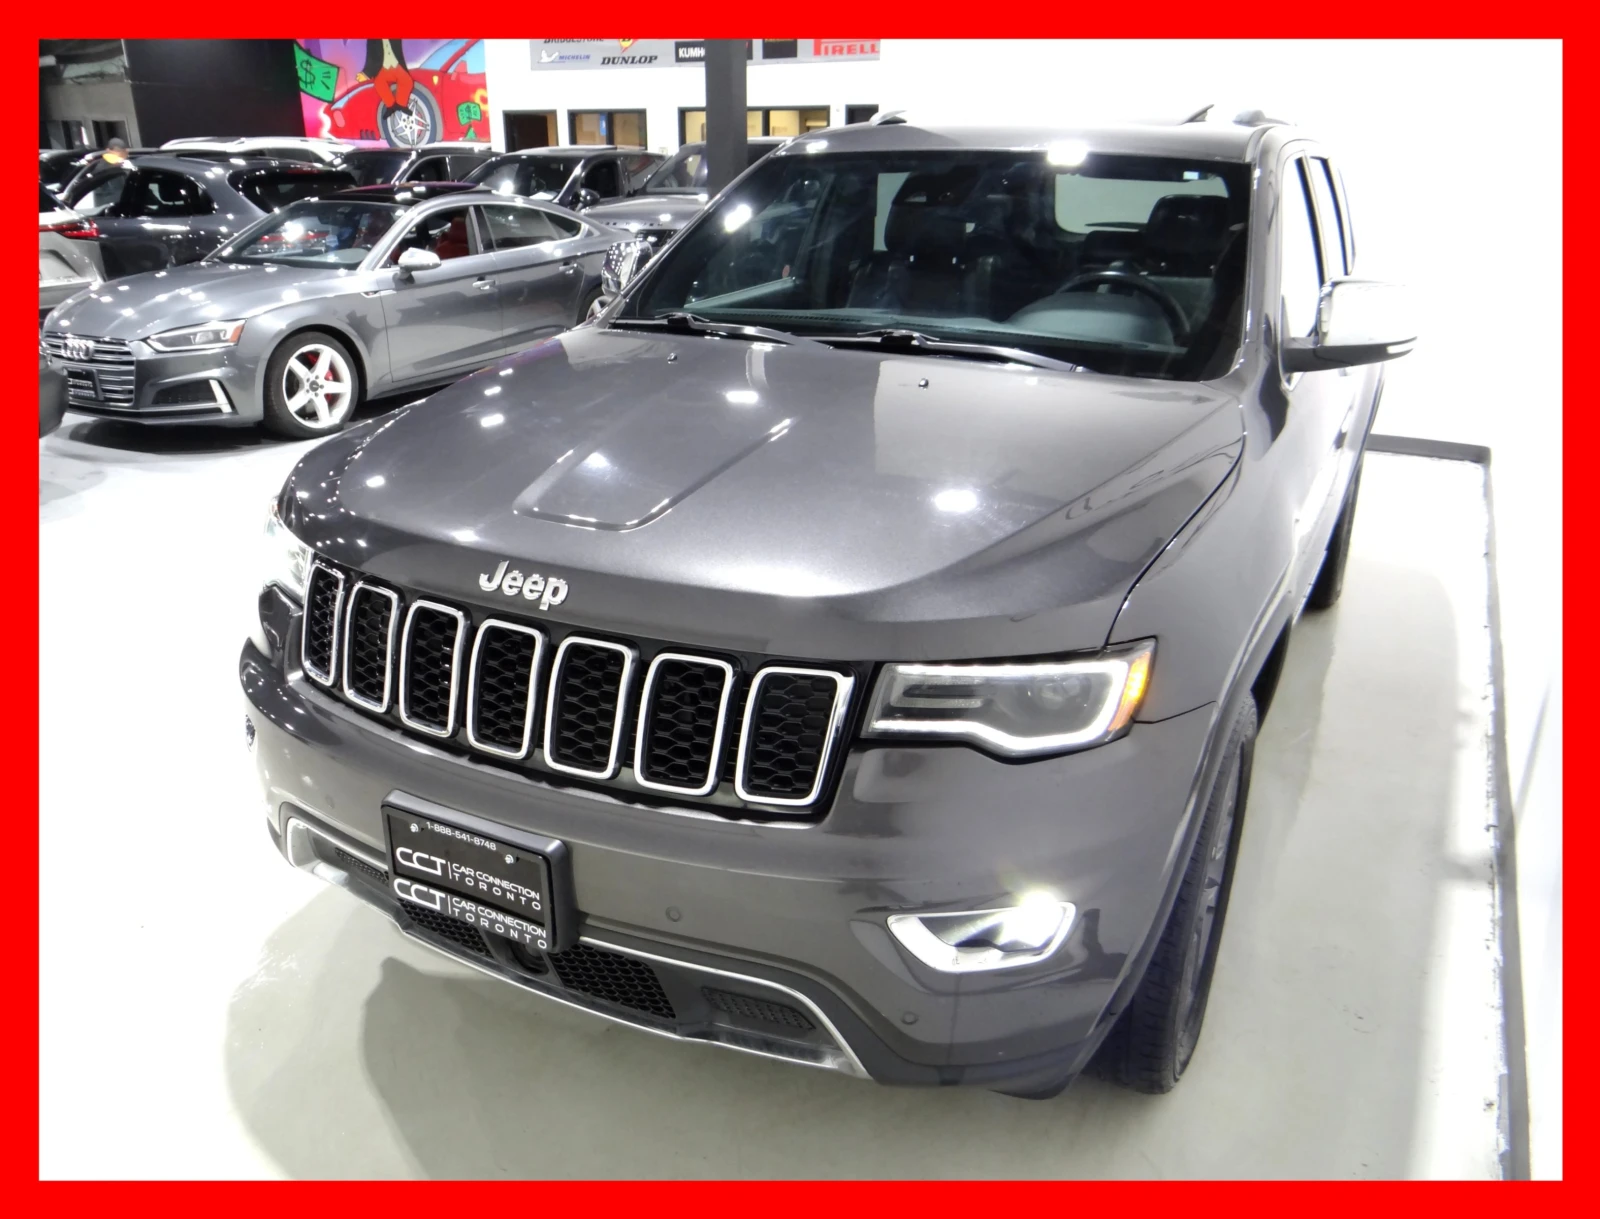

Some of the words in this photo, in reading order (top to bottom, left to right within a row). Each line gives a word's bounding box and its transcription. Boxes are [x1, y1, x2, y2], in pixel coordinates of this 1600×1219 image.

[600, 55, 658, 65] DUNLOP
[678, 47, 706, 59] KUMH
[478, 560, 569, 611] Jeep
[426, 821, 497, 851] 1-888-541-8748
[395, 846, 446, 876] CCT
[393, 878, 446, 910] CCT
[452, 863, 475, 878] CAR
[475, 871, 540, 900] CONNECTION
[453, 873, 541, 911] TORONTO
[452, 897, 476, 913] CAR
[477, 905, 547, 939] CONNECTION
[453, 908, 548, 949] TORONTO
